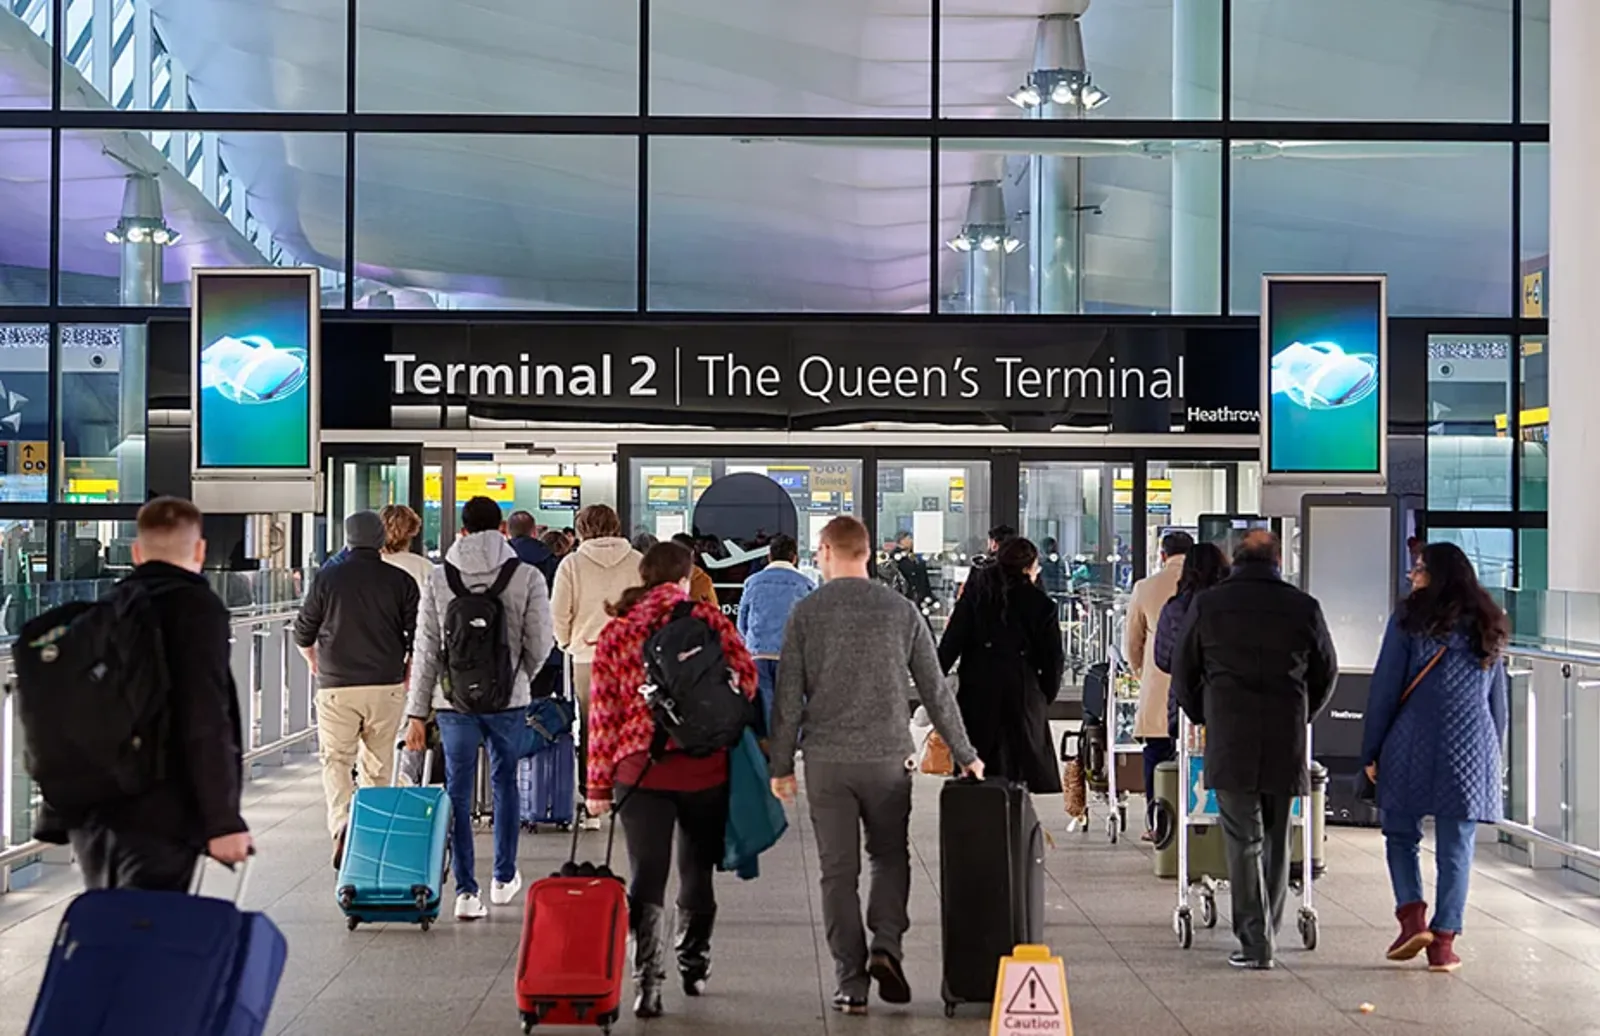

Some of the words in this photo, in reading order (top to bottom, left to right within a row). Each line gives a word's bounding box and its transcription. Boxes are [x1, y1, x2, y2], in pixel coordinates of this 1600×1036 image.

[384, 354, 611, 396] Terminal
[629, 355, 657, 396] 2
[697, 352, 780, 396] The
[798, 355, 980, 403] Queen's
[995, 356, 1184, 398] Terminal
[1187, 405, 1261, 422] Heathrow
[1004, 1016, 1060, 1030] Caution
